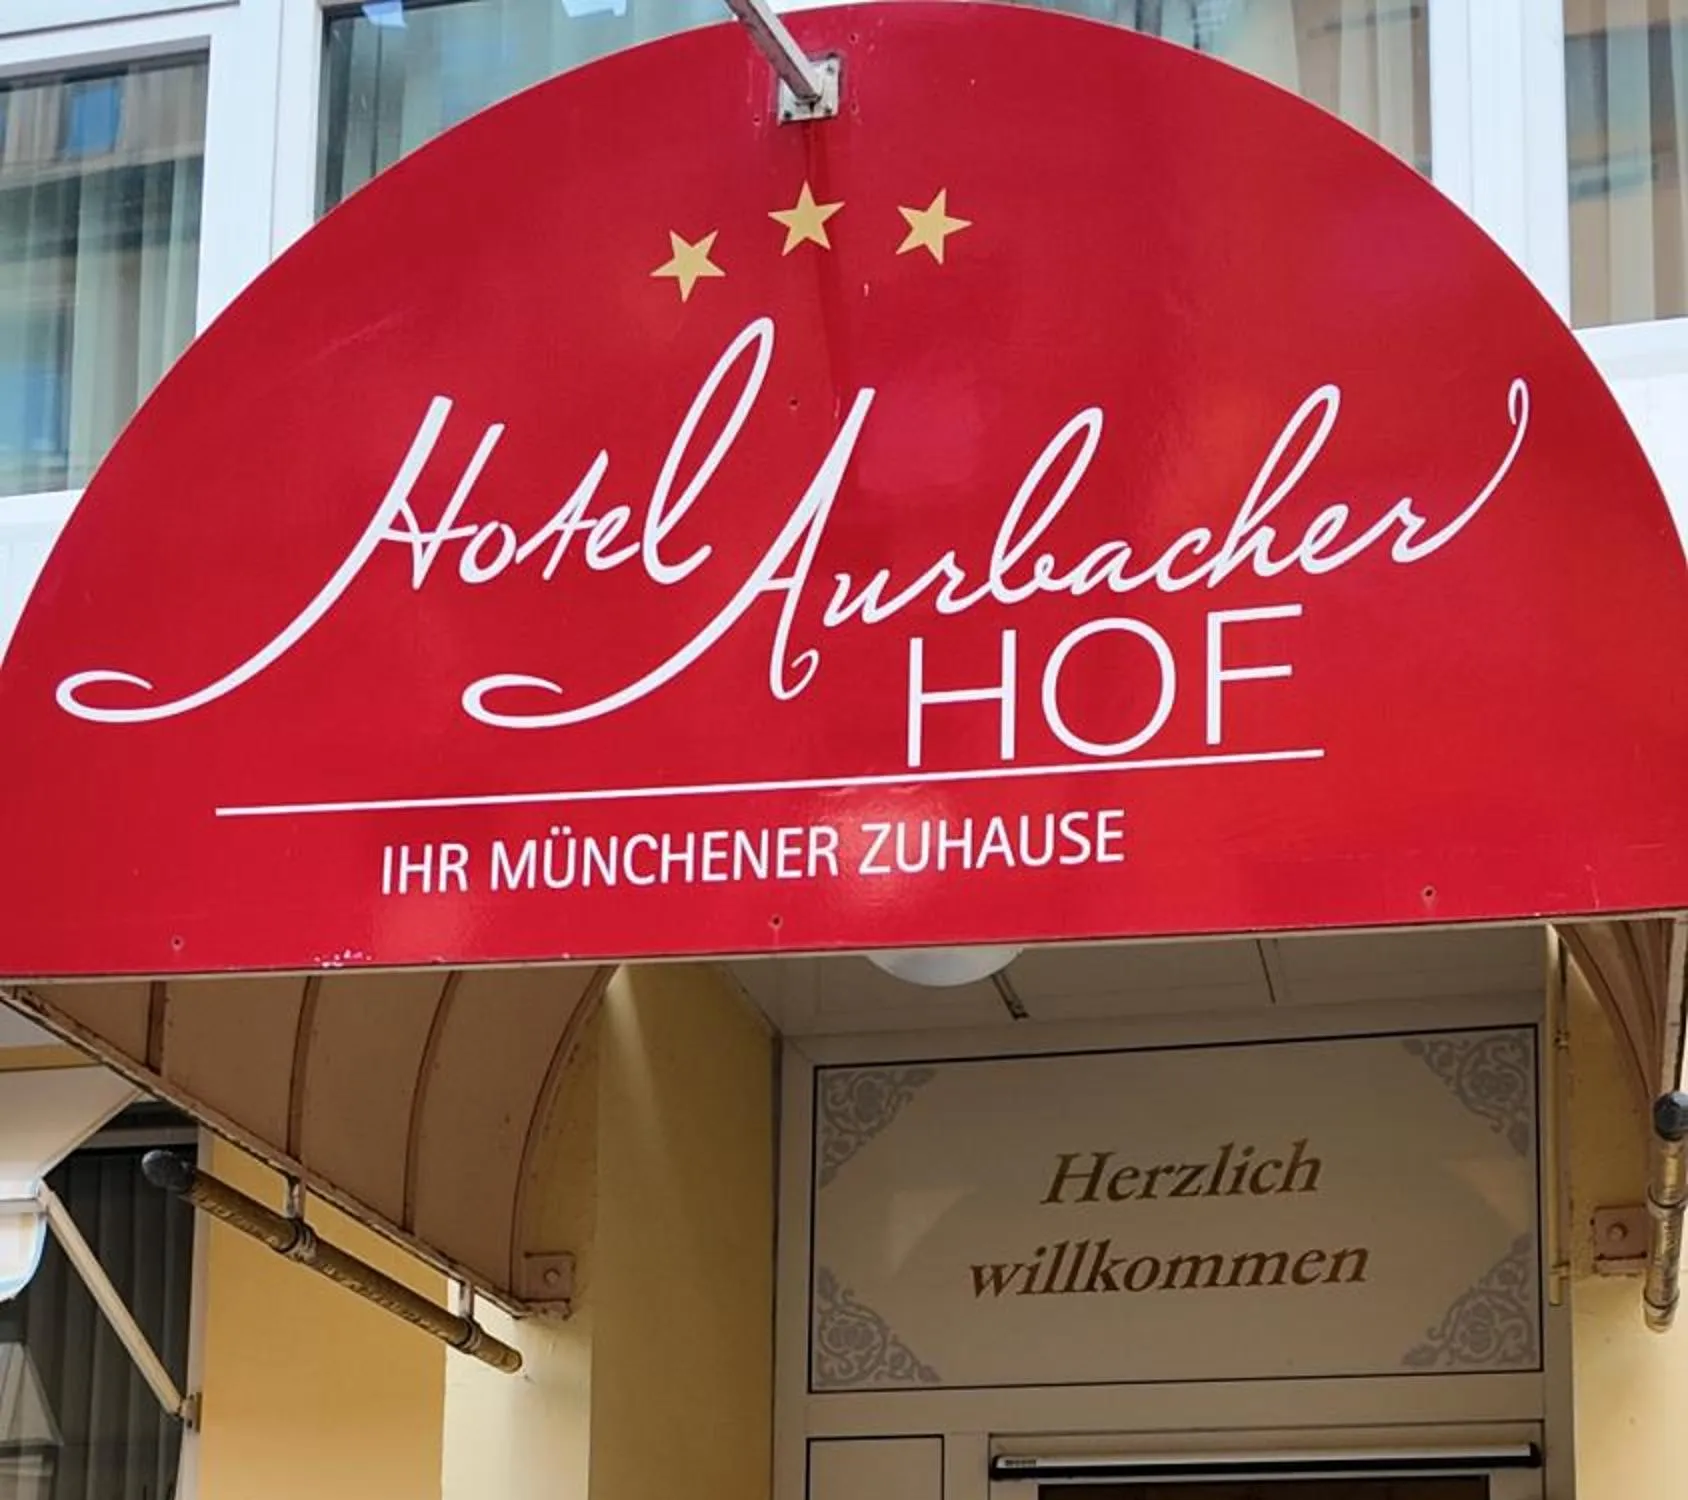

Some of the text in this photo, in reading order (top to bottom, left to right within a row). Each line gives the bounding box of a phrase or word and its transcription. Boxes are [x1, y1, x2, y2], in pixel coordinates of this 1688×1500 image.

[56, 316, 1530, 730] Hotel Aurbacher
[906, 603, 1304, 768] HOF
[380, 808, 1126, 896] IHR MÜNCHENER ZUHAUSE
[1039, 1138, 1322, 1205] Herzlich
[969, 1239, 1371, 1299] willkommen
